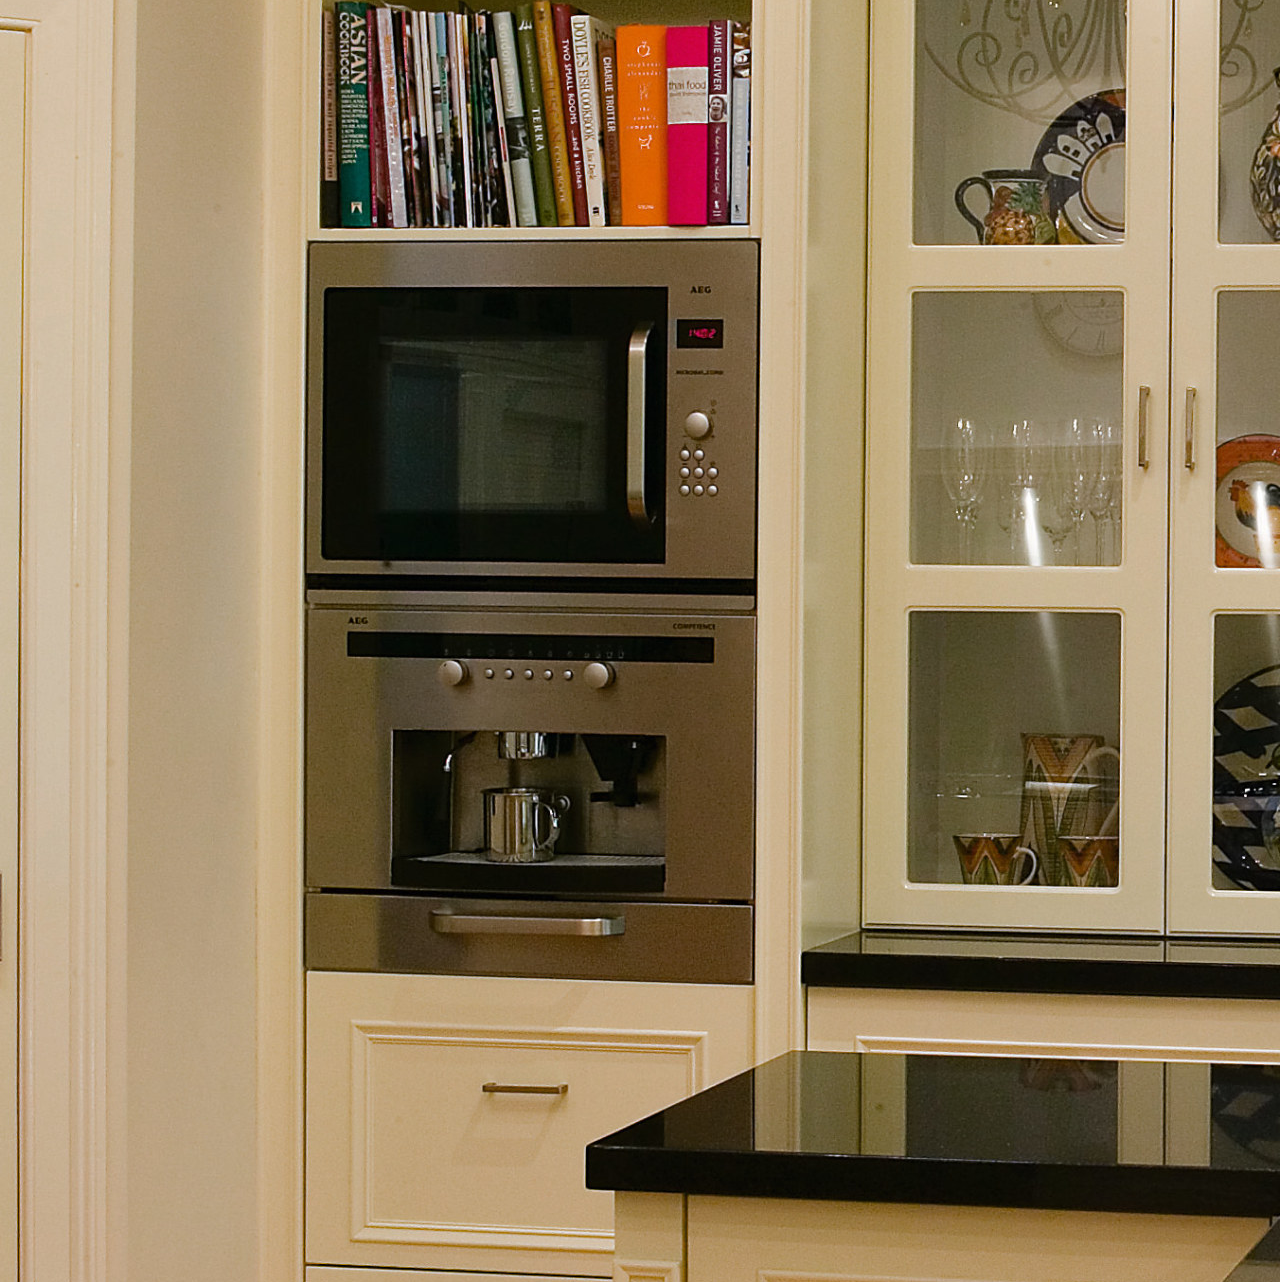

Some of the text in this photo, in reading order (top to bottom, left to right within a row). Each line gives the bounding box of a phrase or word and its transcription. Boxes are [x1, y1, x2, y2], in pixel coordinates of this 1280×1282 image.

[339, 12, 350, 85] COOKBOOK
[350, 12, 367, 85] ASIAN
[561, 38, 571, 62] TWO
[572, 21, 590, 68] DOYLE'S
[713, 24, 723, 54] JAMIE
[498, 21, 519, 114] Gordon Ramsay
[564, 63, 574, 91] SMALL
[577, 70, 590, 90] FISH
[602, 56, 615, 93] CHARLIE
[713, 56, 723, 91] OLIVER
[668, 79, 706, 90] thai food
[567, 93, 578, 125] ROOMS
[580, 91, 596, 141] COOKBOOK
[605, 94, 617, 132] TROTTER
[531, 106, 546, 152] TERRA
[574, 160, 584, 190] kitchen
[586, 163, 598, 180] Doyle
[690, 285, 712, 294] AEG
[348, 616, 369, 625] AEG
[672, 622, 716, 631] COMPETENCE
